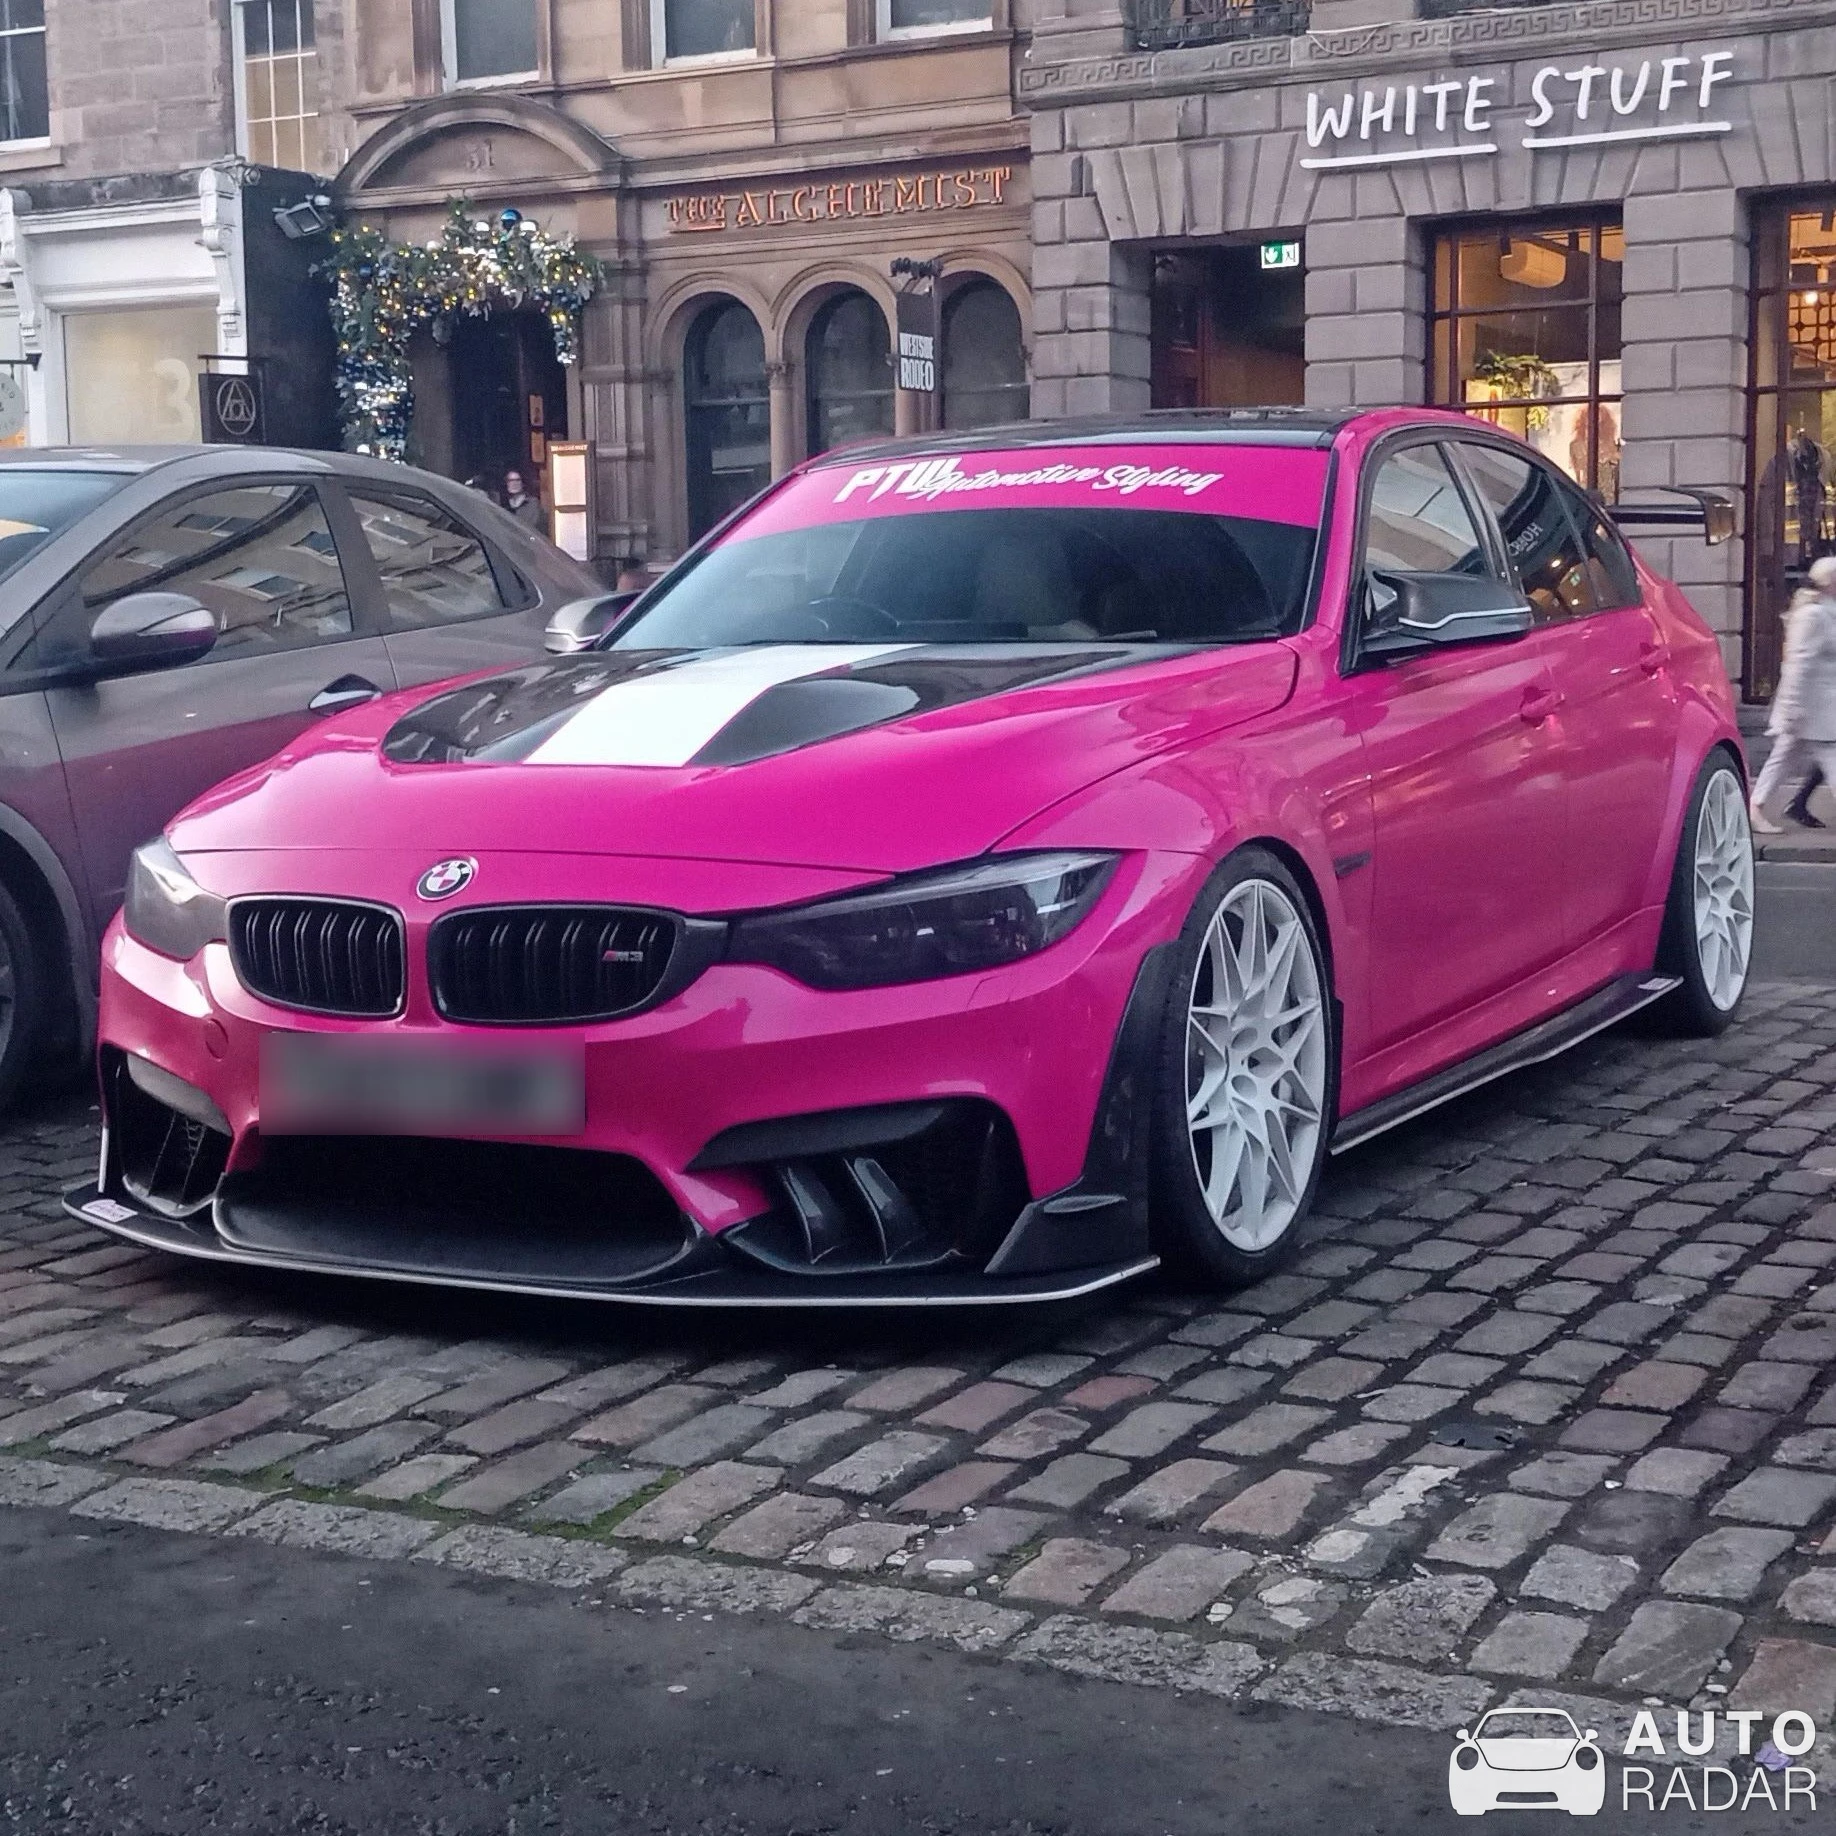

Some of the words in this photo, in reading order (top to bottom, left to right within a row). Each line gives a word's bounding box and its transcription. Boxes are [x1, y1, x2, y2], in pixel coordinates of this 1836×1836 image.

[1306, 76, 1495, 147] WHITE
[1524, 51, 1734, 128] STUFF
[662, 194, 727, 230] THE
[735, 166, 1012, 229] ALCHEMIST
[900, 357, 935, 392] RODEO
[832, 458, 960, 504] PTW
[906, 464, 1104, 501] Automotive
[1091, 464, 1225, 496] Styling
